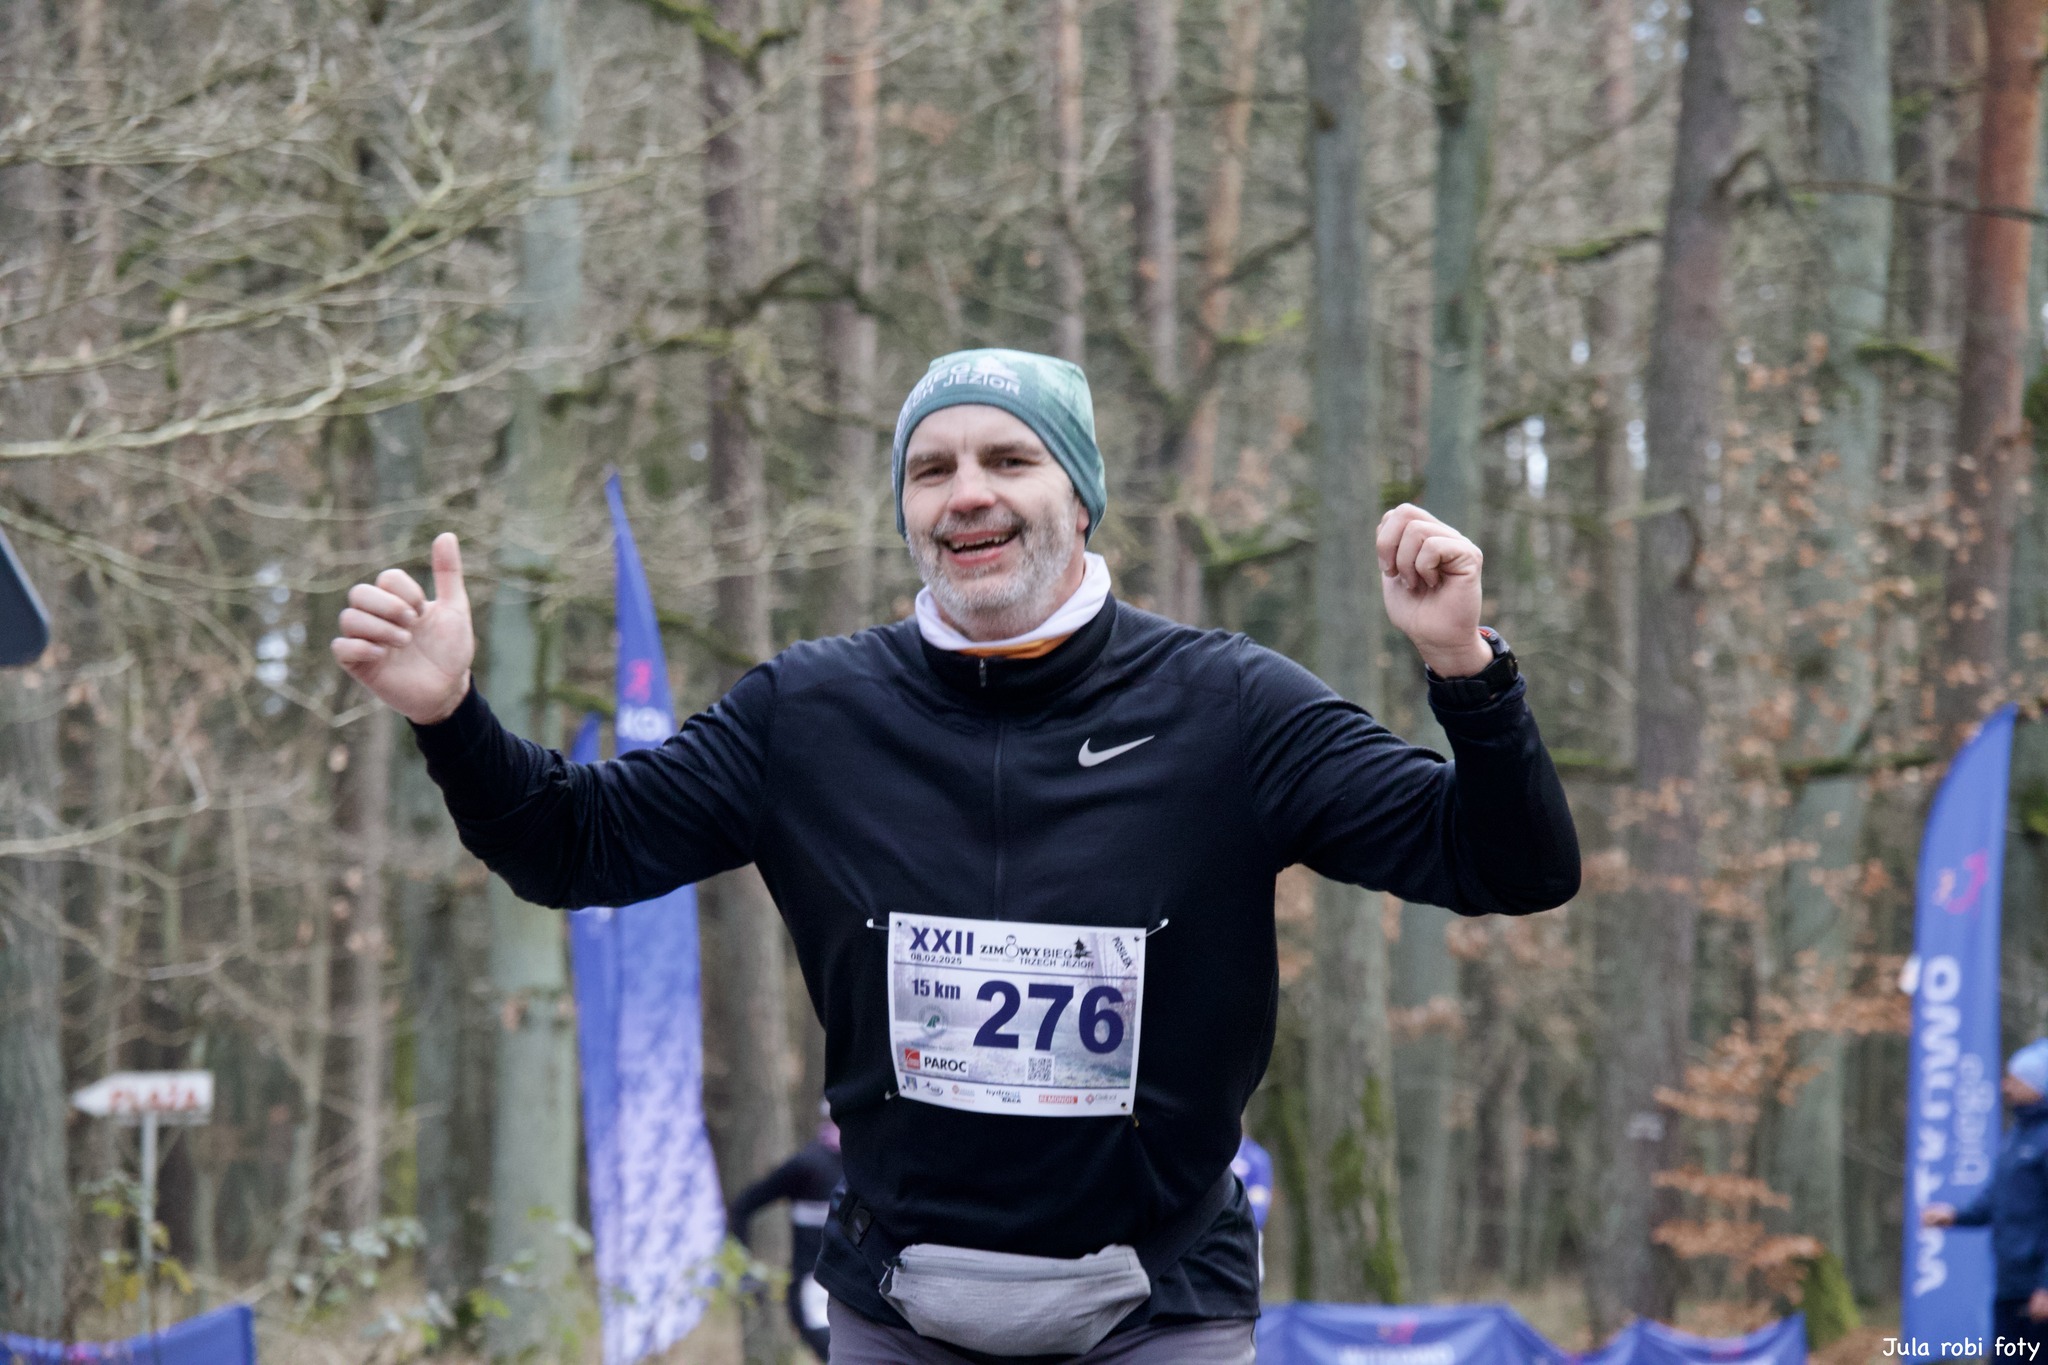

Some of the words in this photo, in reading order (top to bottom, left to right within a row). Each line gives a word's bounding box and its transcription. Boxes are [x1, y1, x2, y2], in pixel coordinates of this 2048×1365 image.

[942, 373, 1020, 398] JEZIOR
[909, 927, 974, 956] XXII
[910, 953, 963, 965] 08.02.2025
[1020, 958, 1057, 967] TRZECH
[1060, 959, 1095, 969] JEZIOR
[1043, 948, 1072, 960] BIEG
[912, 979, 930, 997] 15
[934, 981, 961, 1000] km
[973, 980, 1125, 1055] 276
[924, 1056, 967, 1073] PAROC
